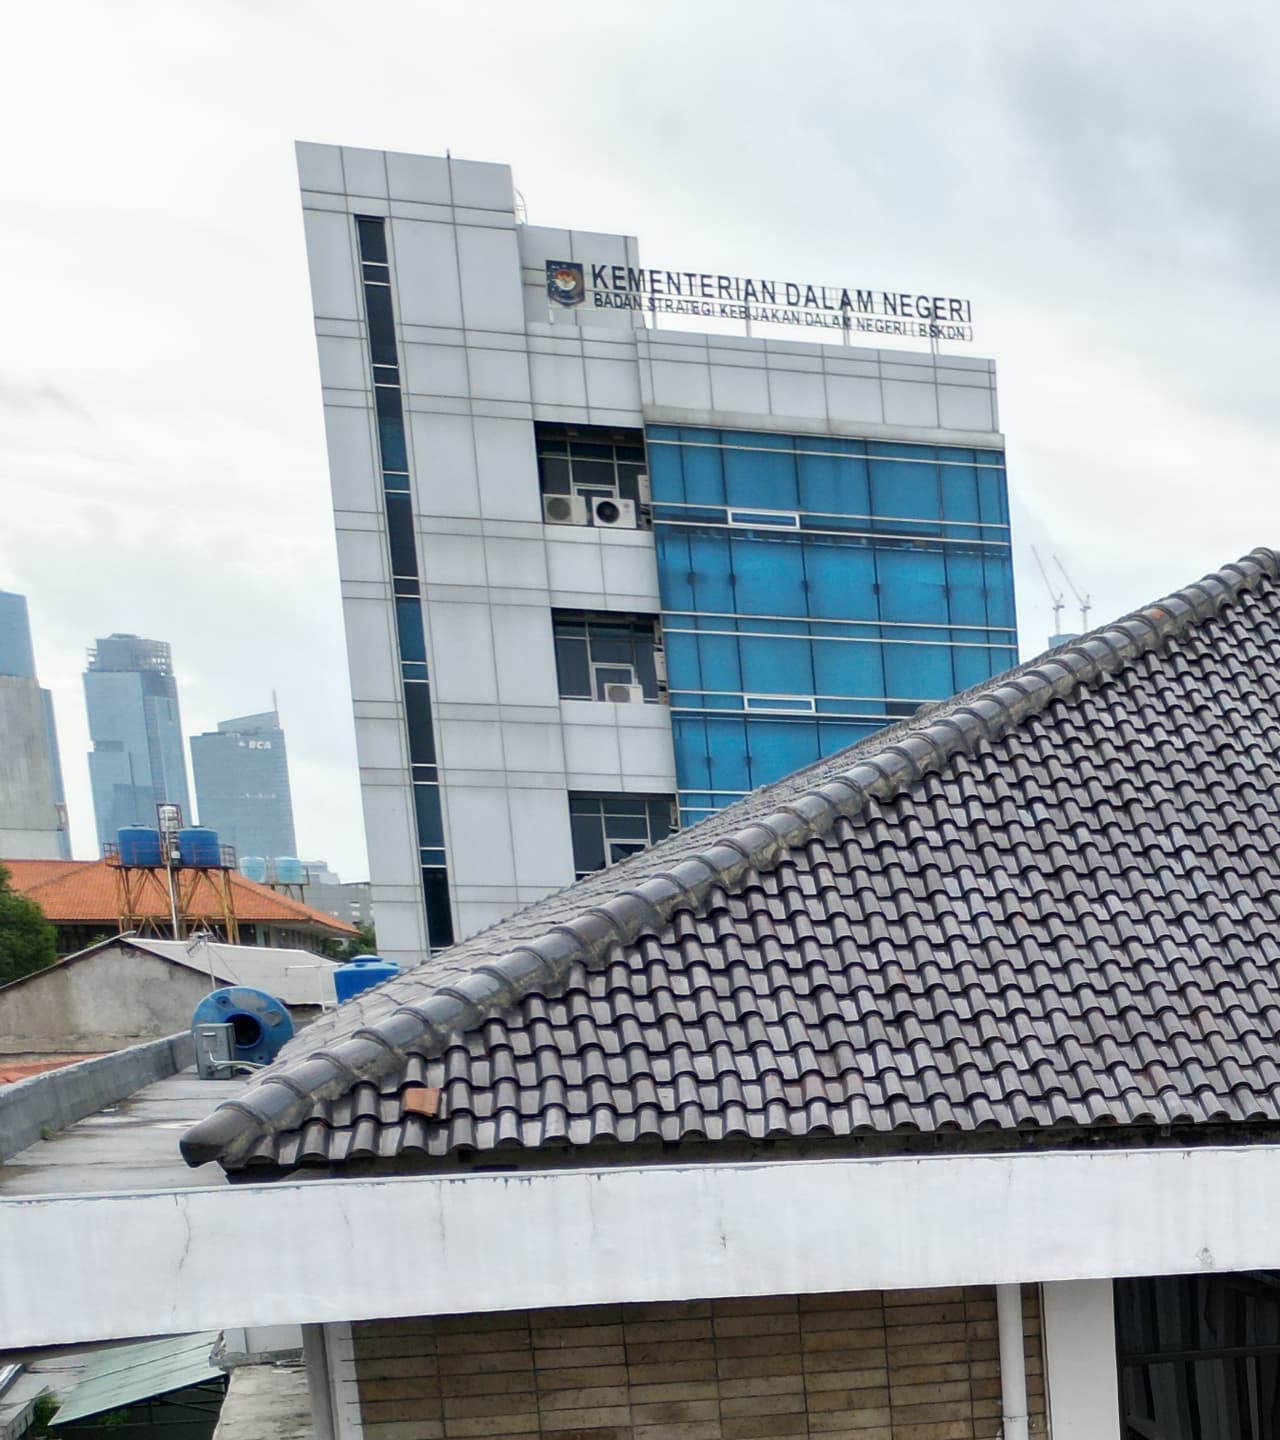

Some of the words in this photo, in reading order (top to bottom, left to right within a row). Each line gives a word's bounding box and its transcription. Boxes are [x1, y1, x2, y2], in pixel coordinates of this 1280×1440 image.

[591, 264, 776, 304] KEMENTERIAN
[786, 283, 874, 314] DALAM
[883, 292, 972, 322] NEGERI
[594, 292, 642, 311] BADAN
[647, 297, 716, 317] STRATEGI
[720, 303, 800, 325] KEBIJAKAN
[856, 317, 907, 336] NEGERI
[248, 740, 272, 749] BCA
